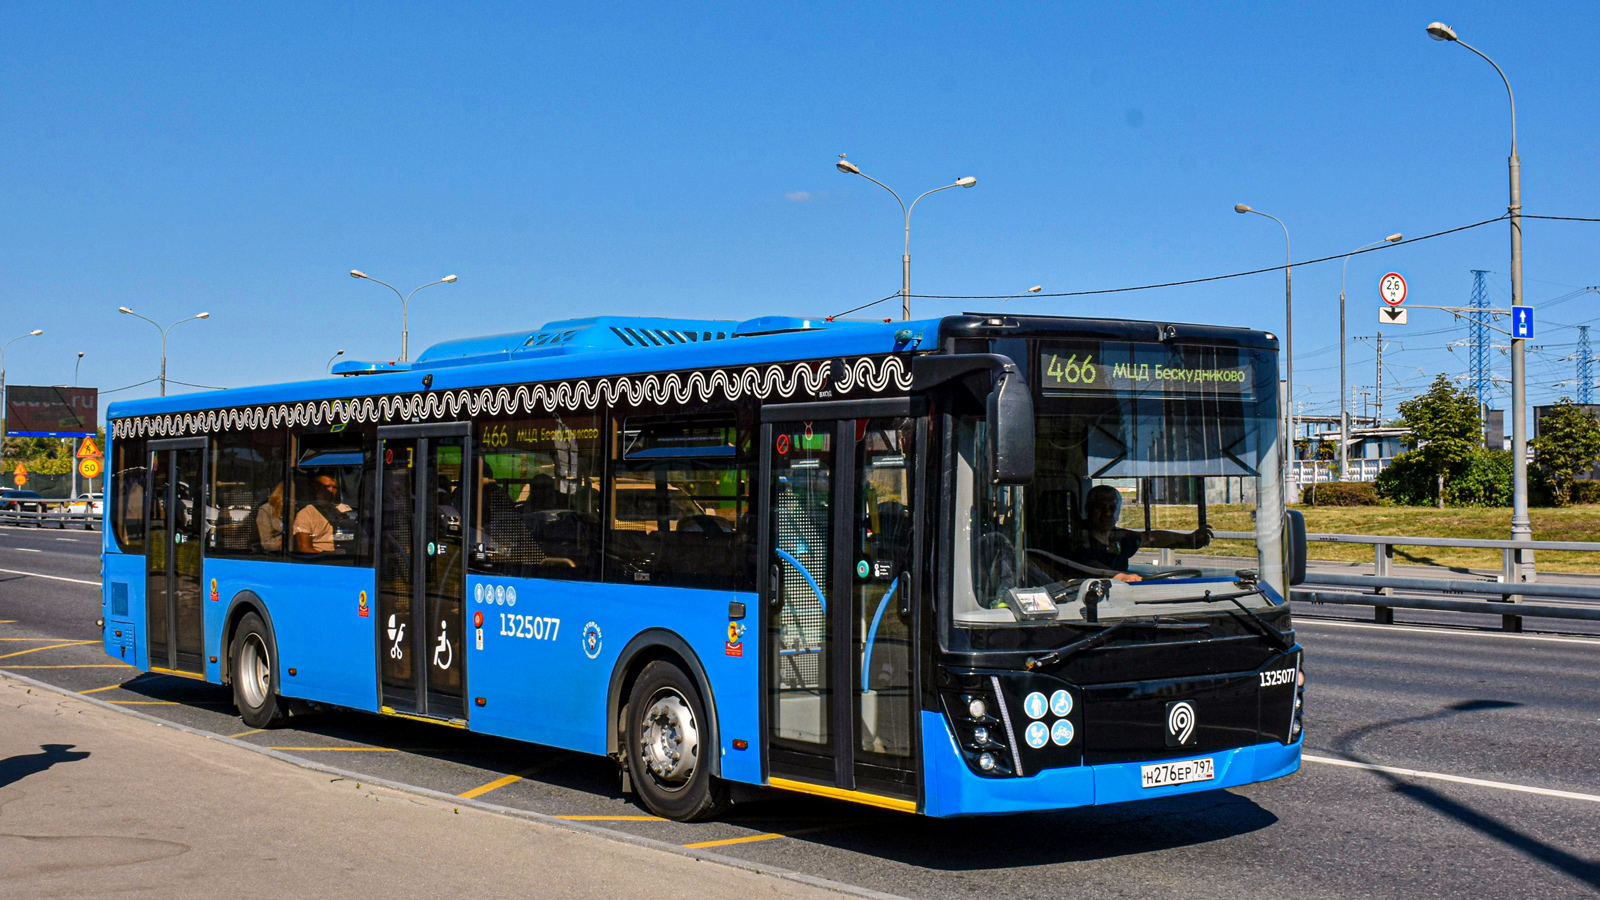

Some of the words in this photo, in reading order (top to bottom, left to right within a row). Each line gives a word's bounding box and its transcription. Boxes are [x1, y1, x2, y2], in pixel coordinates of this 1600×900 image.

[1386, 280, 1400, 291] 2,6
[1047, 354, 1096, 384] 466
[1112, 362, 1149, 382] МЦД
[1155, 364, 1246, 383] Бескудниково
[482, 424, 508, 447] 466
[516, 428, 538, 443] МЦД
[84, 463, 96, 472] 50
[500, 613, 560, 641] 1325077
[1260, 668, 1295, 687] 1325077
[1194, 760, 1211, 774] 797
